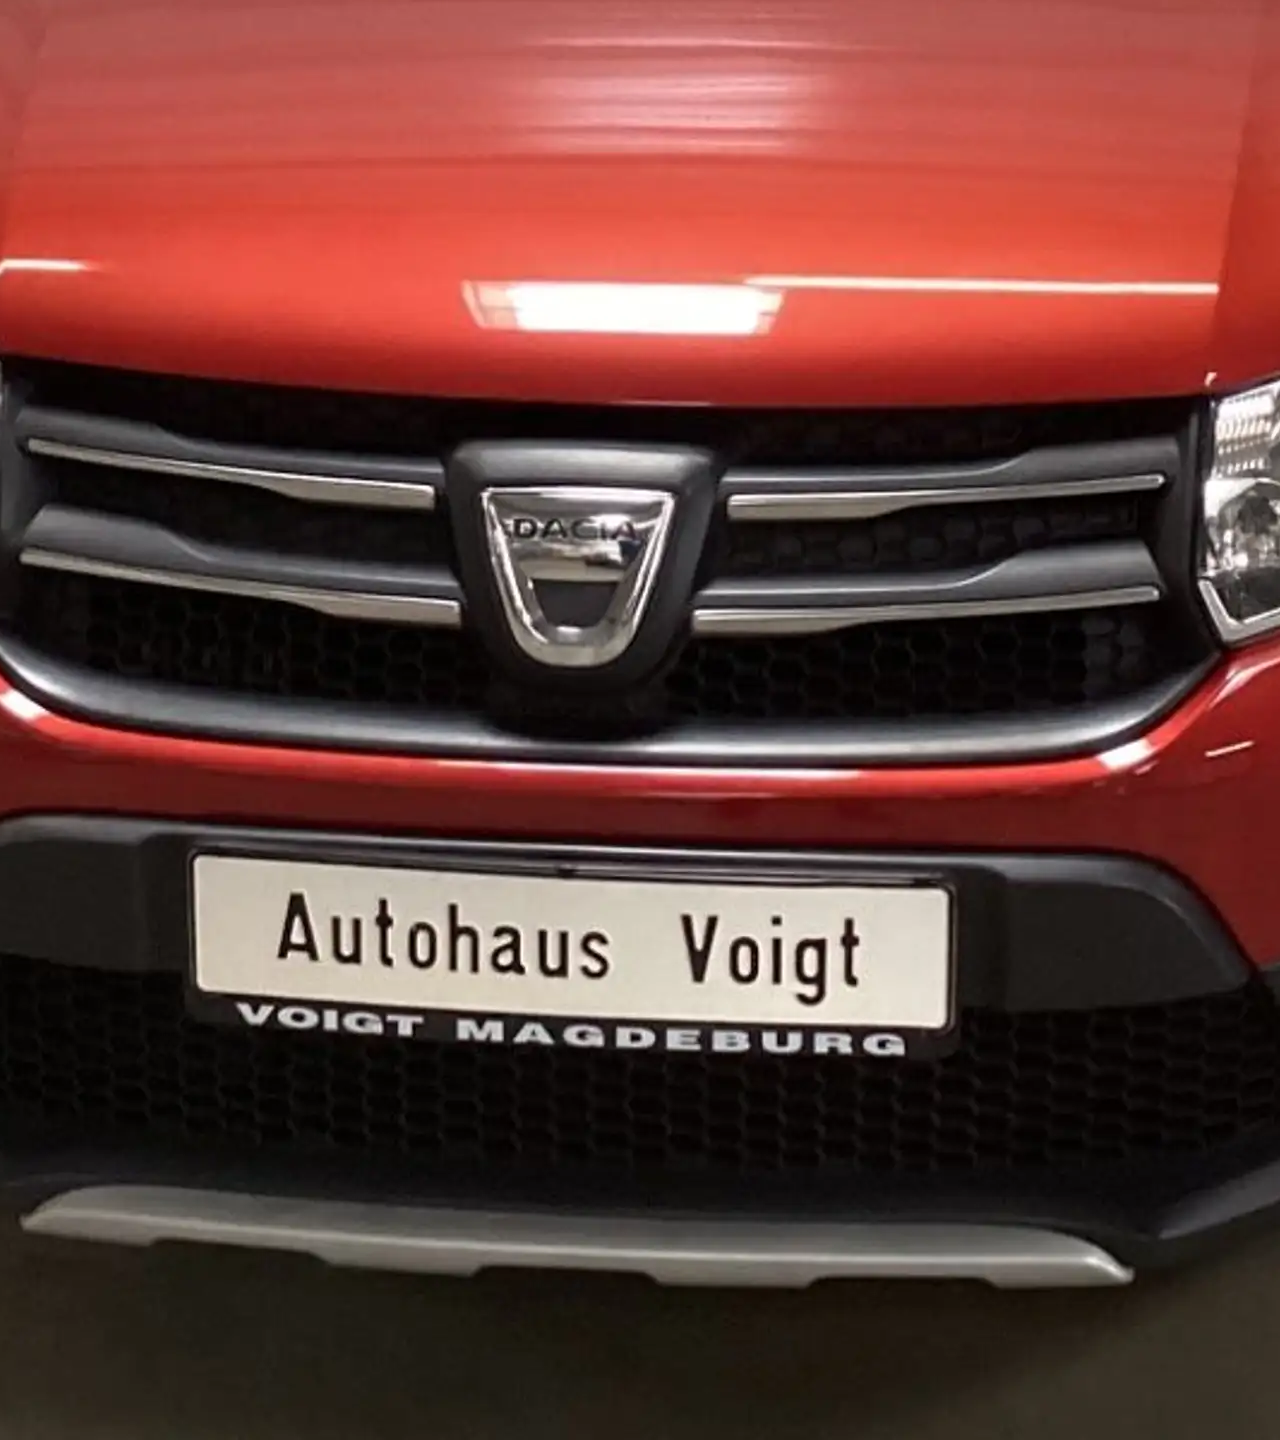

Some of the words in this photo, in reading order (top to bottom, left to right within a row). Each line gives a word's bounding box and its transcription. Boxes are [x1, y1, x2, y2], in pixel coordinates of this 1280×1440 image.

[514, 517, 638, 541] DACIA
[277, 891, 611, 979] Autohaus
[680, 913, 860, 1005] Voigt
[235, 1002, 425, 1036] VOIGT
[454, 1018, 907, 1057] MAGDEBURG
